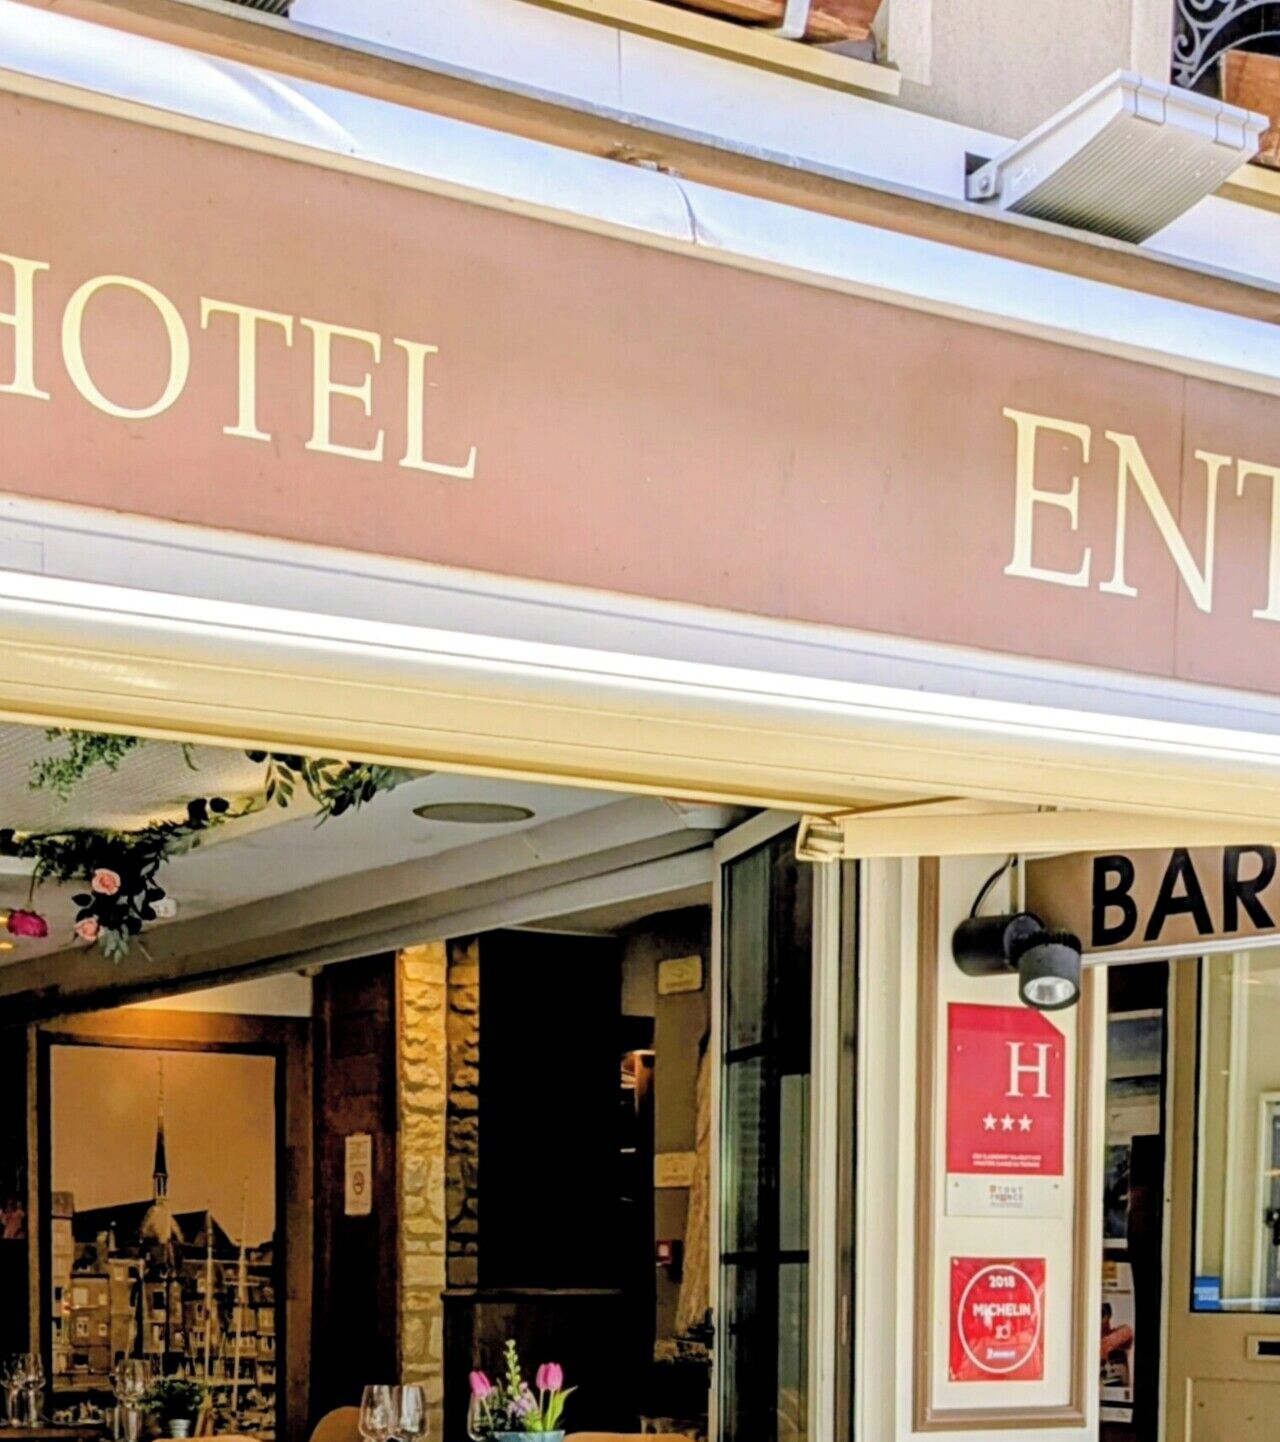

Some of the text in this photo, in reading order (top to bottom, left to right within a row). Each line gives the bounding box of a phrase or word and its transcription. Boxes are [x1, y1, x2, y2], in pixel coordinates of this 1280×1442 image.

[1091, 844, 1276, 947] BAR
[1004, 1041, 1052, 1098] H
[988, 1275, 1016, 1288] 2018
[972, 1303, 1031, 1317] MICHELIN
